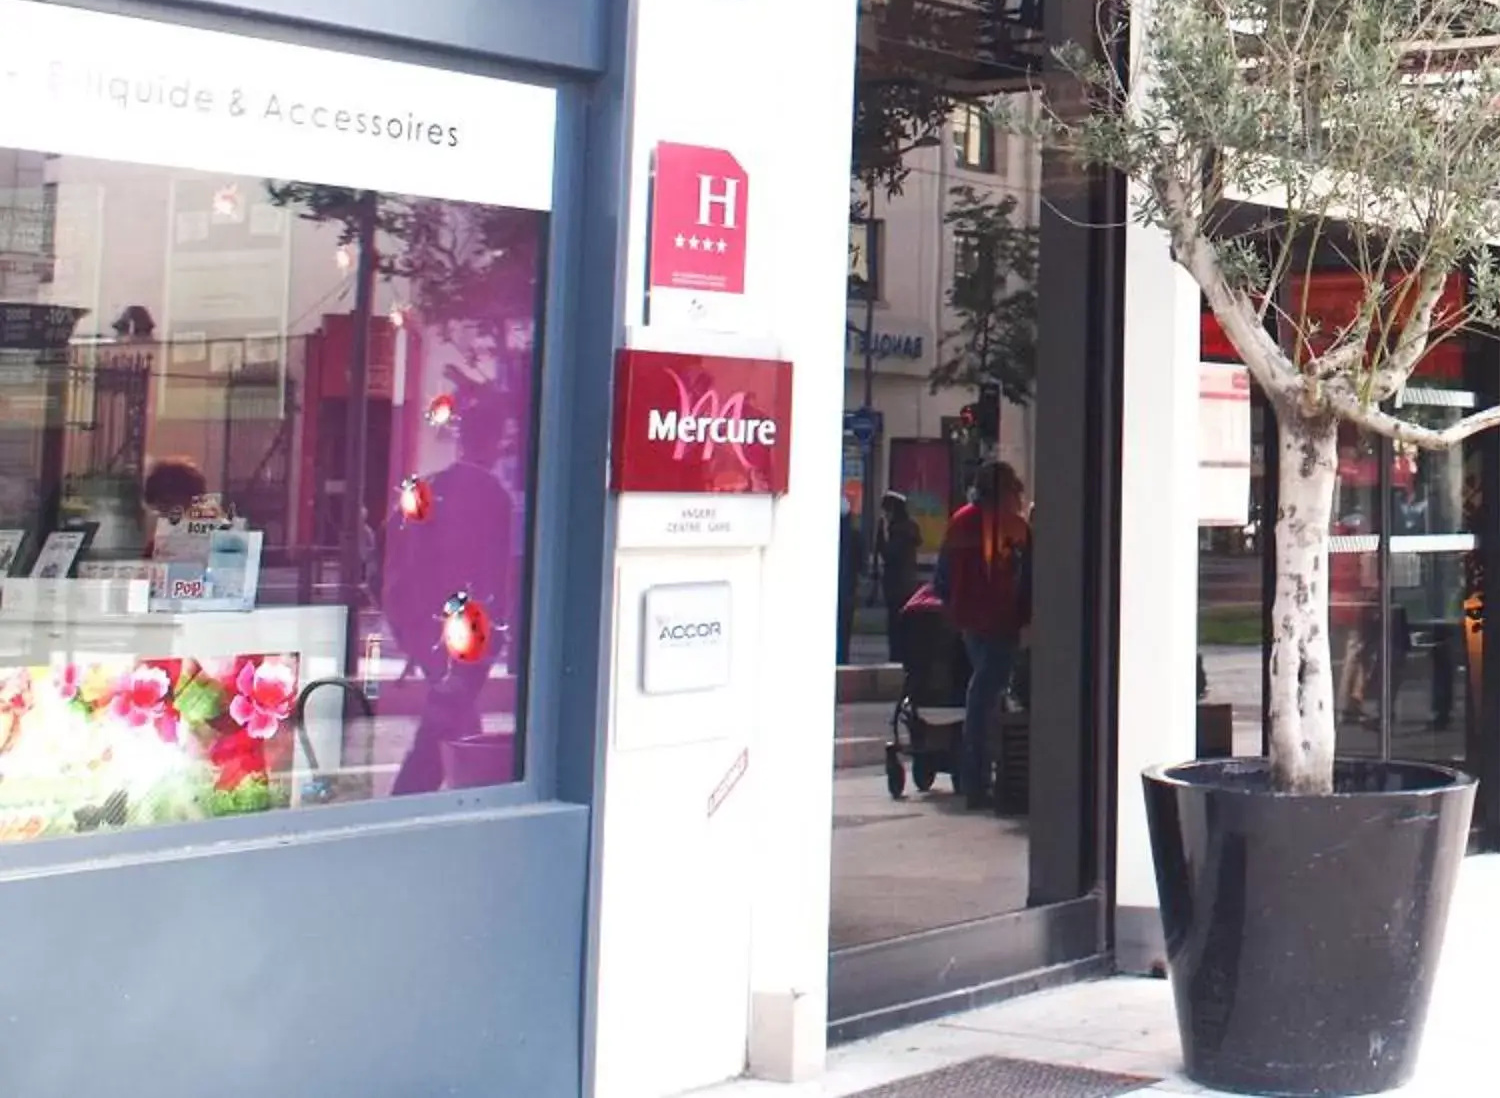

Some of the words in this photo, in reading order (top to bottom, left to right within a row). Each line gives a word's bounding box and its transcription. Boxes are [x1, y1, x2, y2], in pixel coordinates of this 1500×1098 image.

[229, 88, 247, 117] &
[263, 93, 459, 148] Accessoires
[696, 172, 741, 231] H
[648, 408, 776, 445] Mercure
